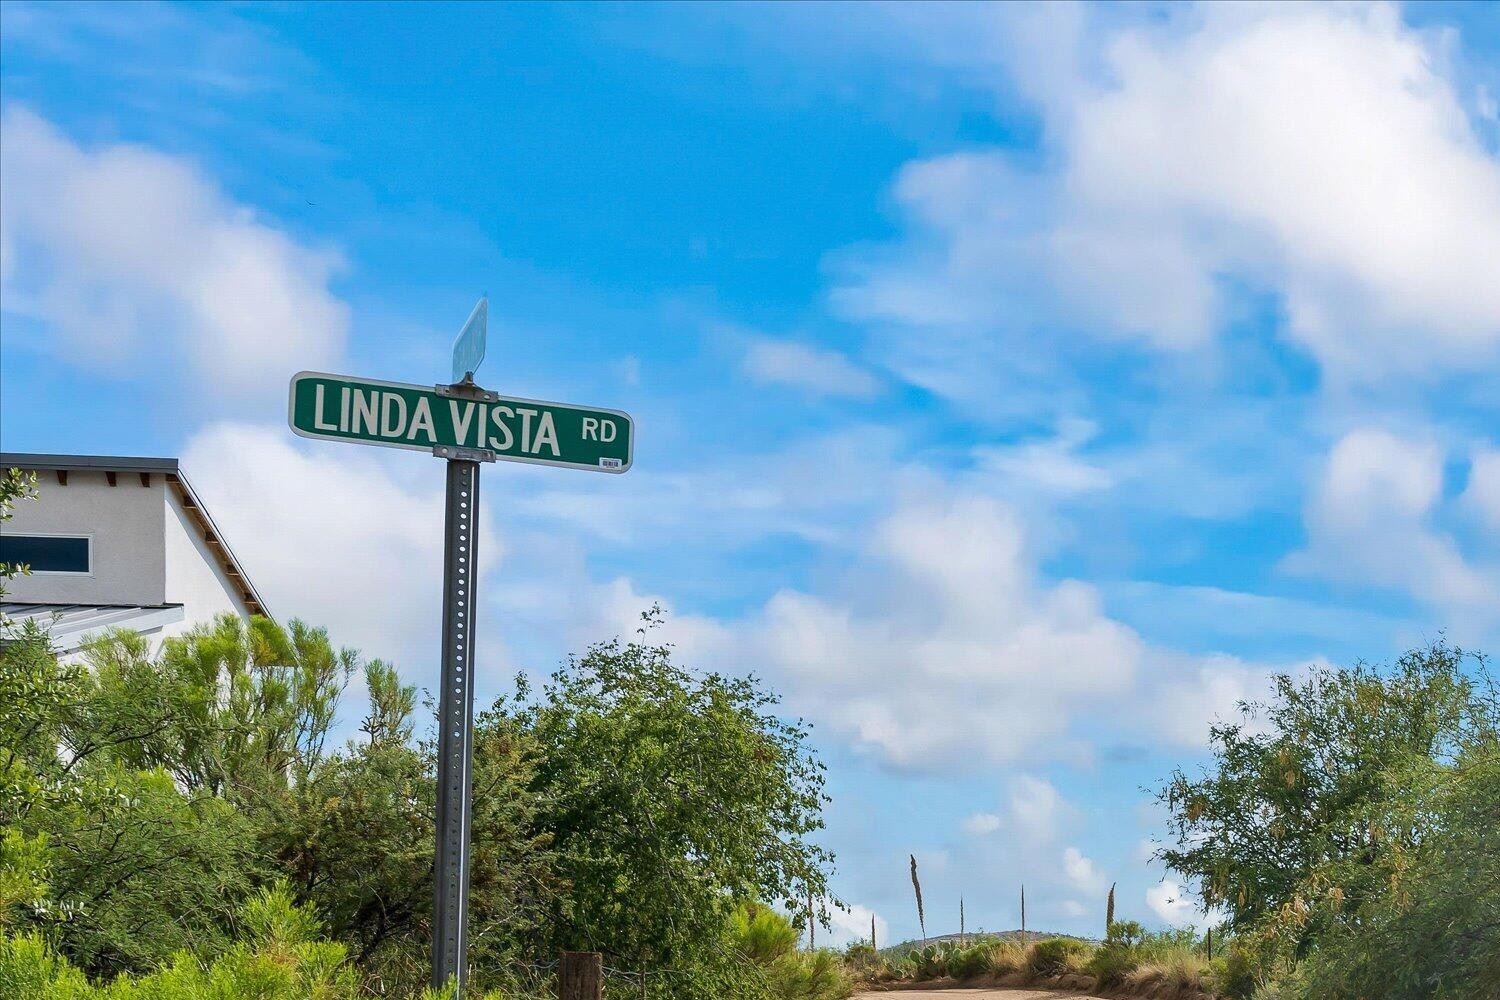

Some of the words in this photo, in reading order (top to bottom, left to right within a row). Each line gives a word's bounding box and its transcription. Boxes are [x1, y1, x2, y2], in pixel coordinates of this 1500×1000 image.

[314, 384, 438, 443] LINDA
[449, 400, 561, 456] VISTA
[581, 417, 617, 443] RD
